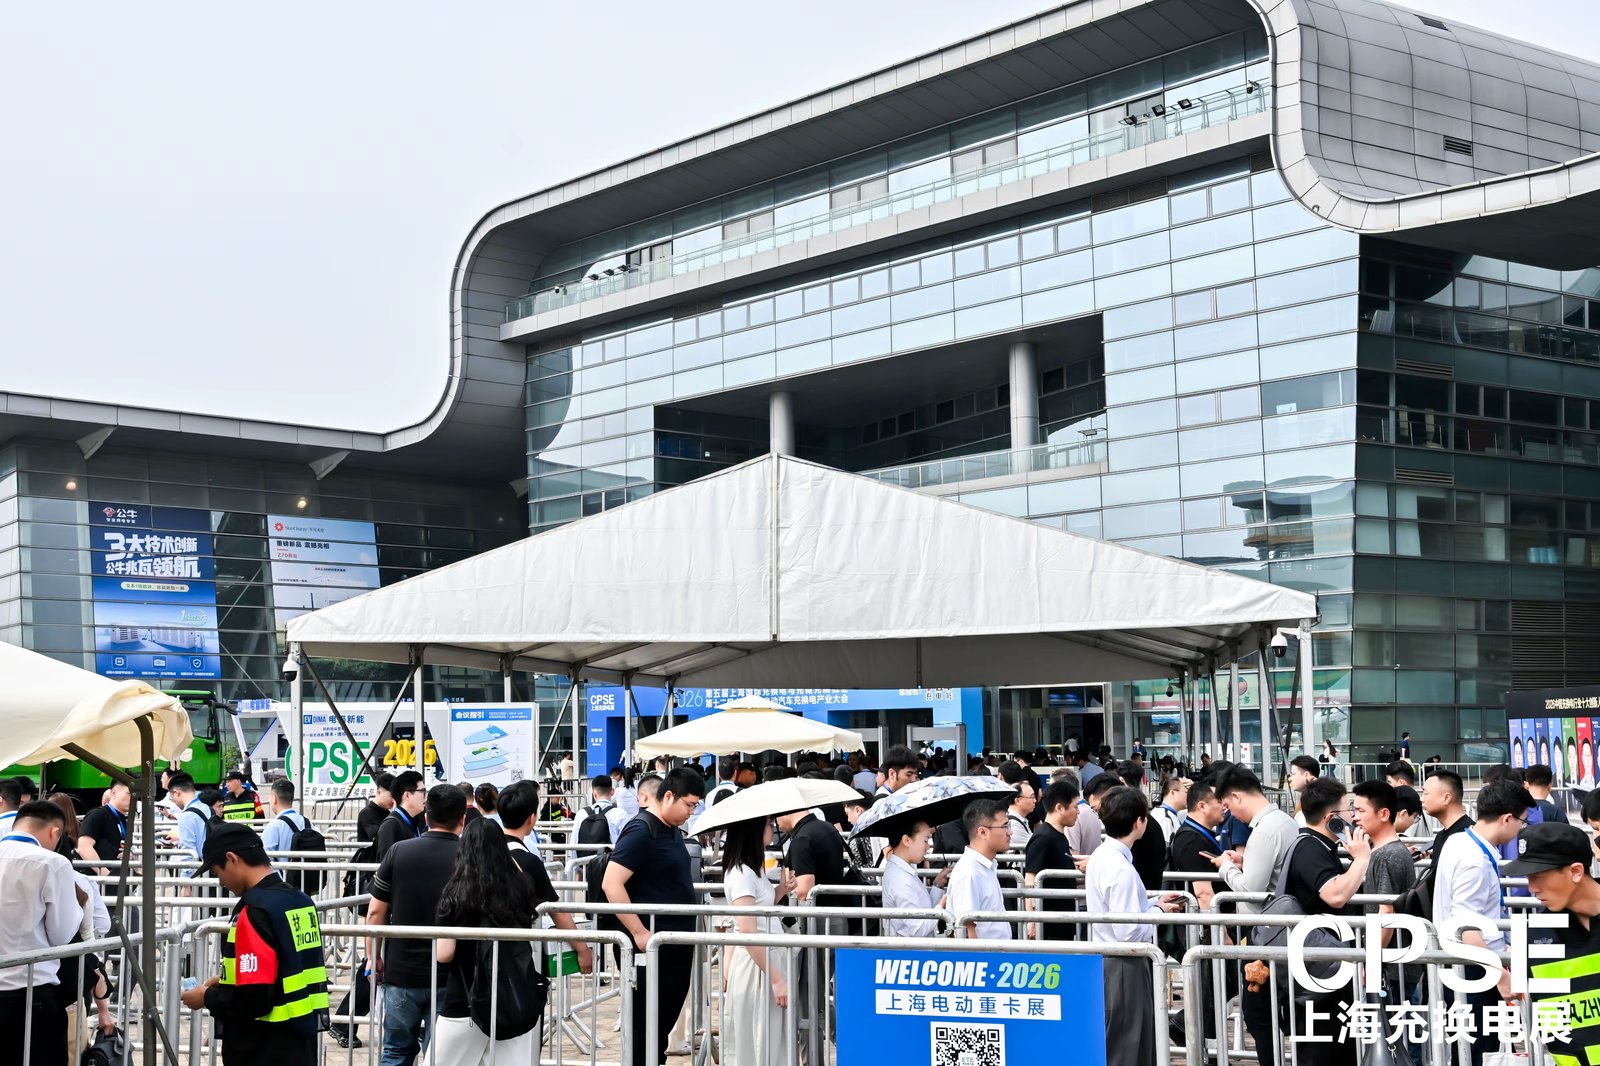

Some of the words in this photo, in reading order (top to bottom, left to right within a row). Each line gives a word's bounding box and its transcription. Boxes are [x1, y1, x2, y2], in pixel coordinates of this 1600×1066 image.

[116, 508, 138, 518] 公牛
[104, 532, 198, 562] 3大技术创新
[105, 555, 201, 578] 公牛兆瓦领航
[590, 694, 615, 705] CPSE
[240, 953, 258, 973] 勤
[885, 994, 1046, 1017] 上海电动重卡展
